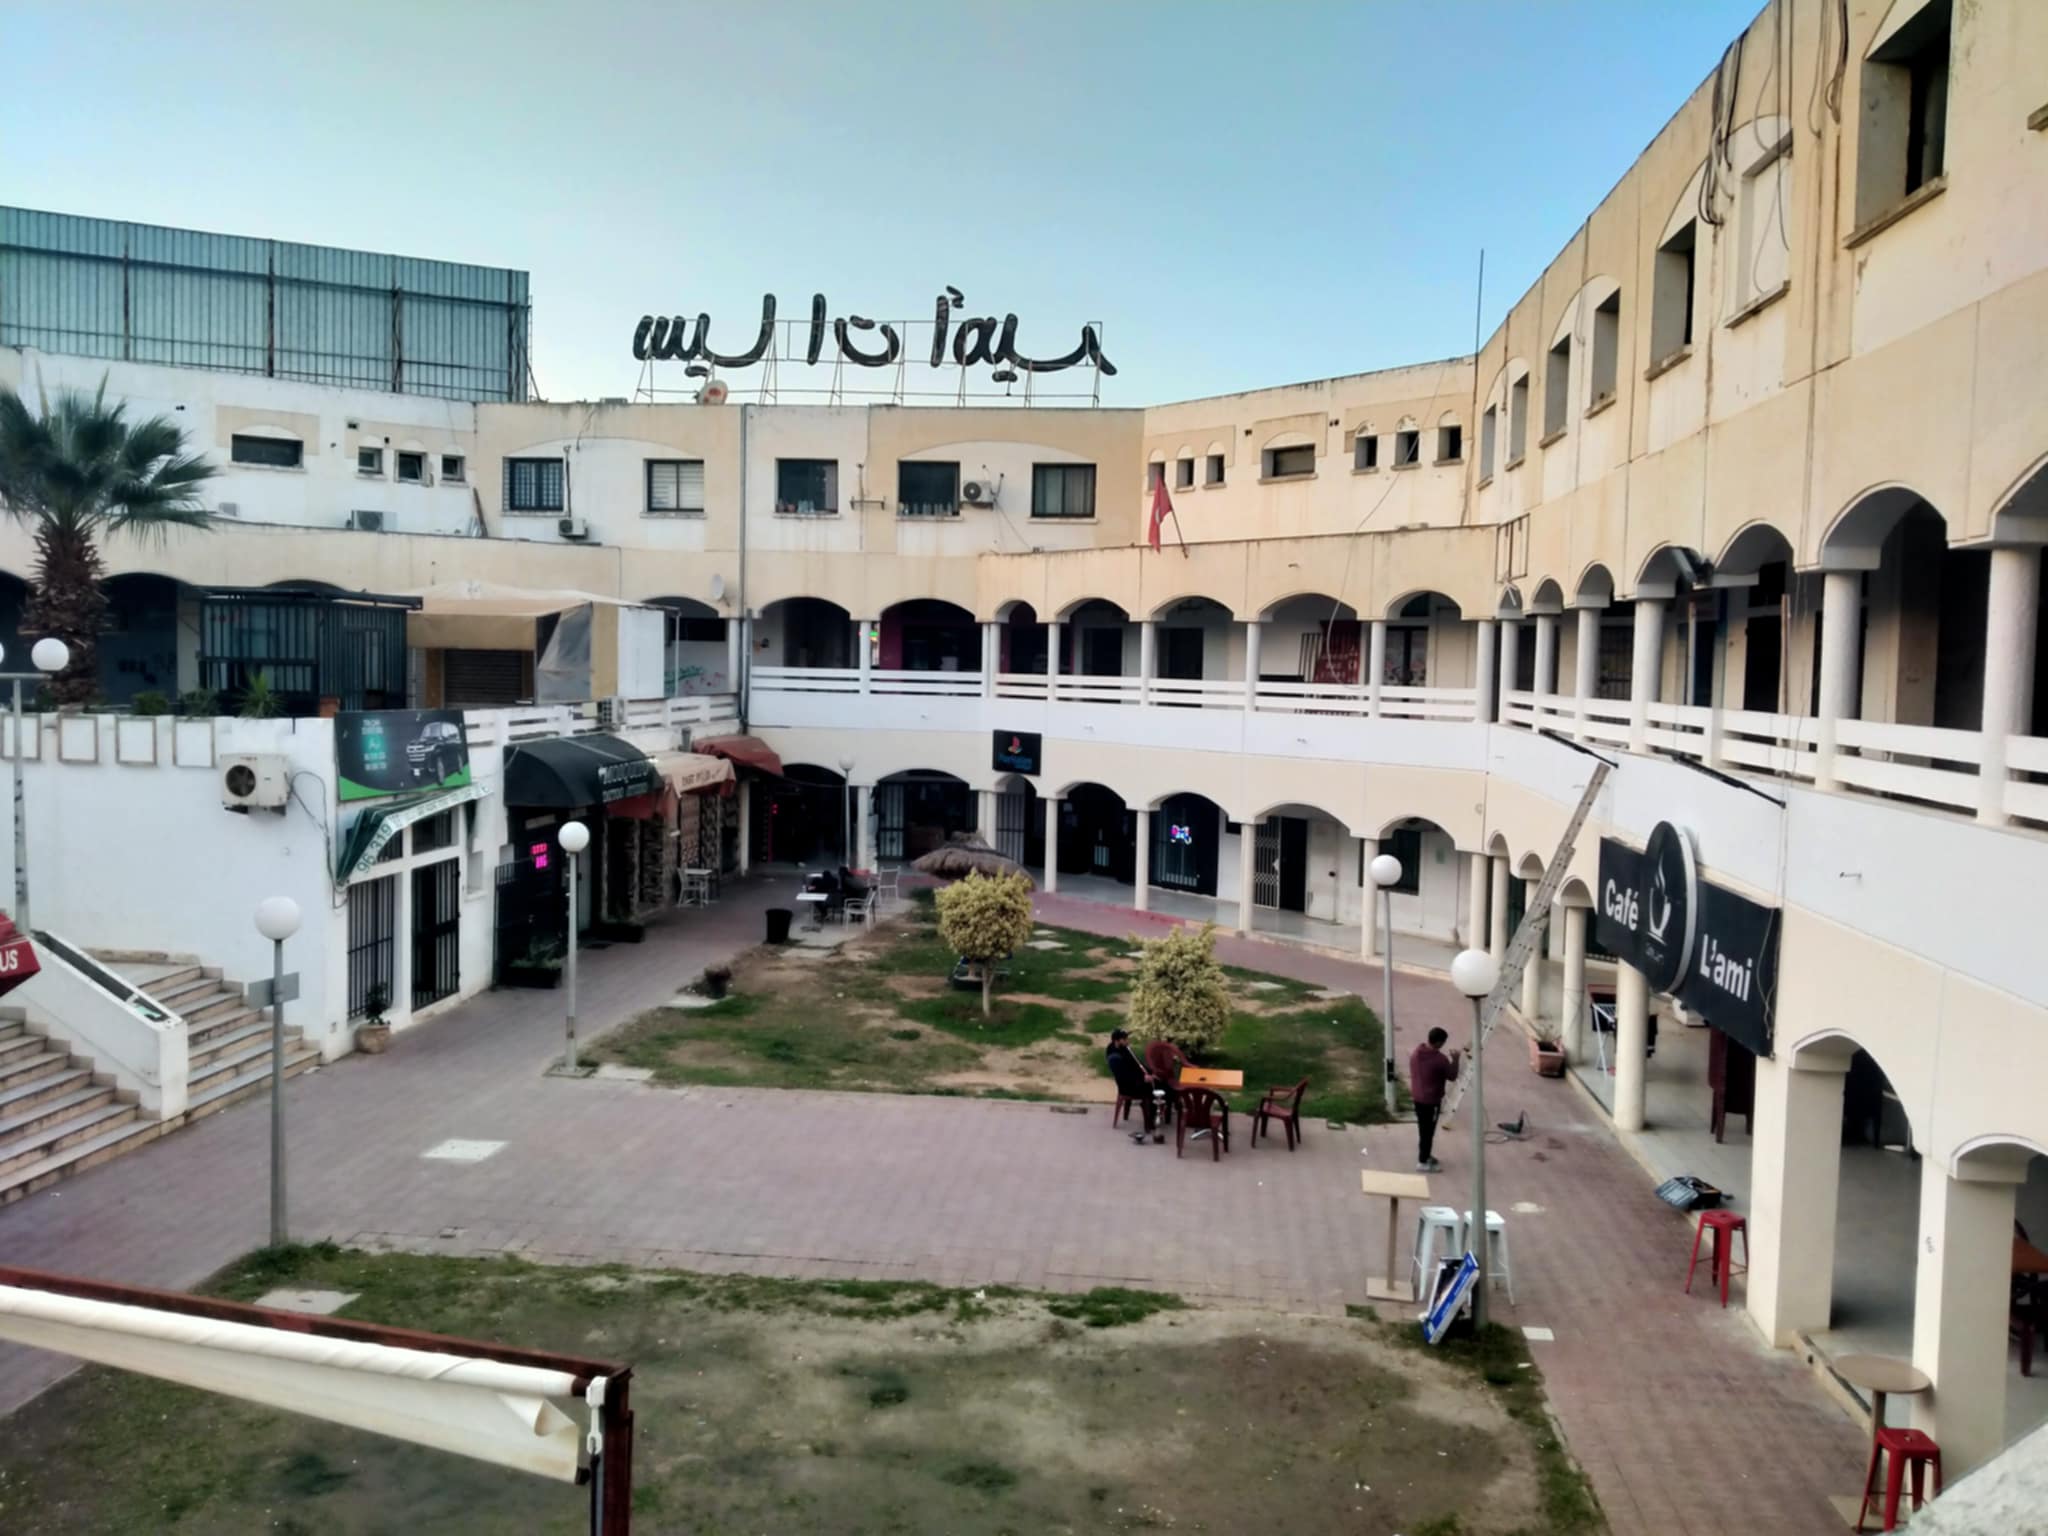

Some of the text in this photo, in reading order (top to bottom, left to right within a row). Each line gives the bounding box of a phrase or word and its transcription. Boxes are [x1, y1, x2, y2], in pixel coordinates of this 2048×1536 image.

[371, 824, 392, 850] 319
[1604, 878, 1752, 1002] Café L'ami
